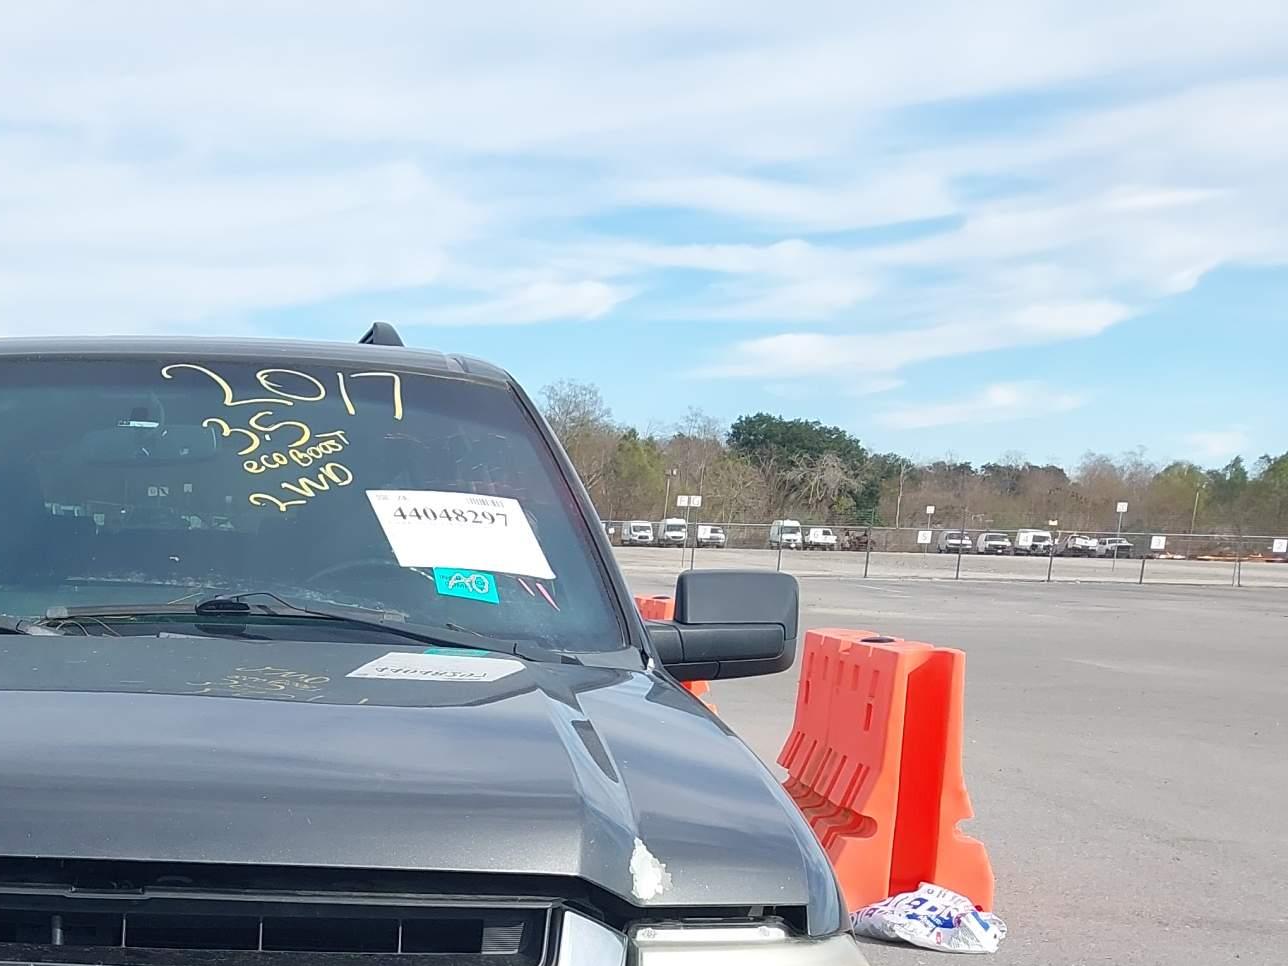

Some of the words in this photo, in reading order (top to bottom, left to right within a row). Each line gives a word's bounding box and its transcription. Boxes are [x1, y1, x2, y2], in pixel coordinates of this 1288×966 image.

[161, 363, 403, 421] 2017
[202, 411, 311, 456] 3.5
[393, 506, 509, 527] 44048297
